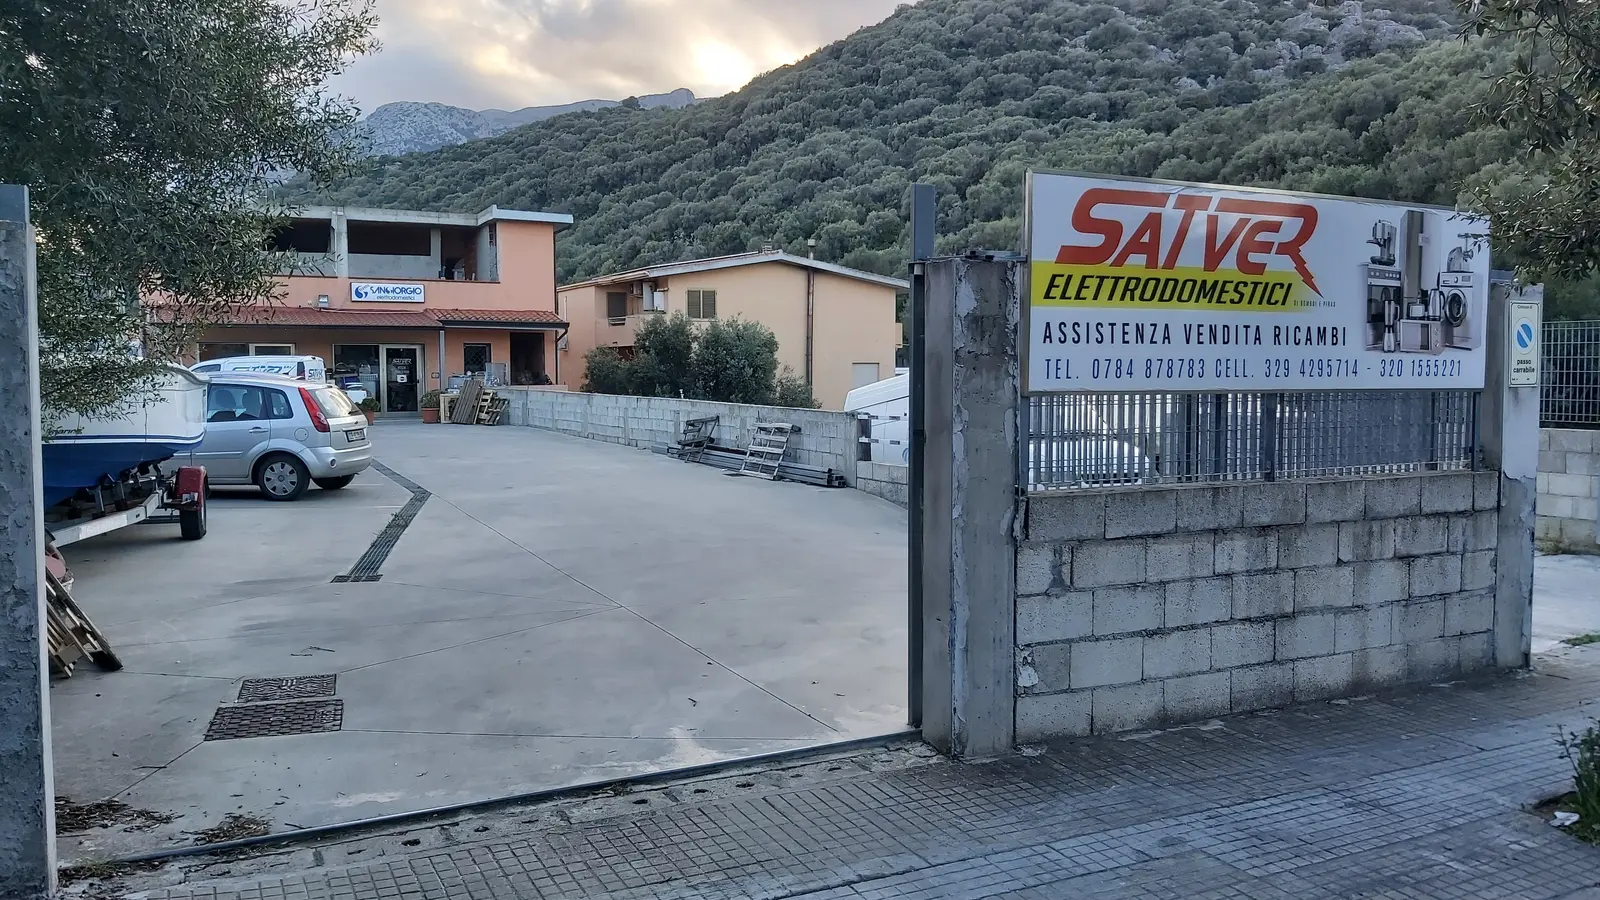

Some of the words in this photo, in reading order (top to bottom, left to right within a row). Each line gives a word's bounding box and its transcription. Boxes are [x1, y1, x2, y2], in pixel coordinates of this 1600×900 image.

[1054, 187, 1323, 298] SATVER
[1043, 273, 1292, 306] ELETTRODOMESTICI
[1043, 321, 1172, 345] ASSISTENZA
[1183, 323, 1262, 346] VENDITA
[1273, 325, 1347, 346] RICAMBI
[1045, 358, 1079, 379] TEL.
[1092, 358, 1134, 379] 0784
[1144, 358, 1205, 379] 878783
[1215, 358, 1254, 378] CELL.
[1264, 358, 1290, 378] 329
[1299, 358, 1359, 378] 4295714
[1380, 358, 1404, 378] 320
[1411, 358, 1462, 377] 1555221
[1513, 366, 1535, 374] carrabile
